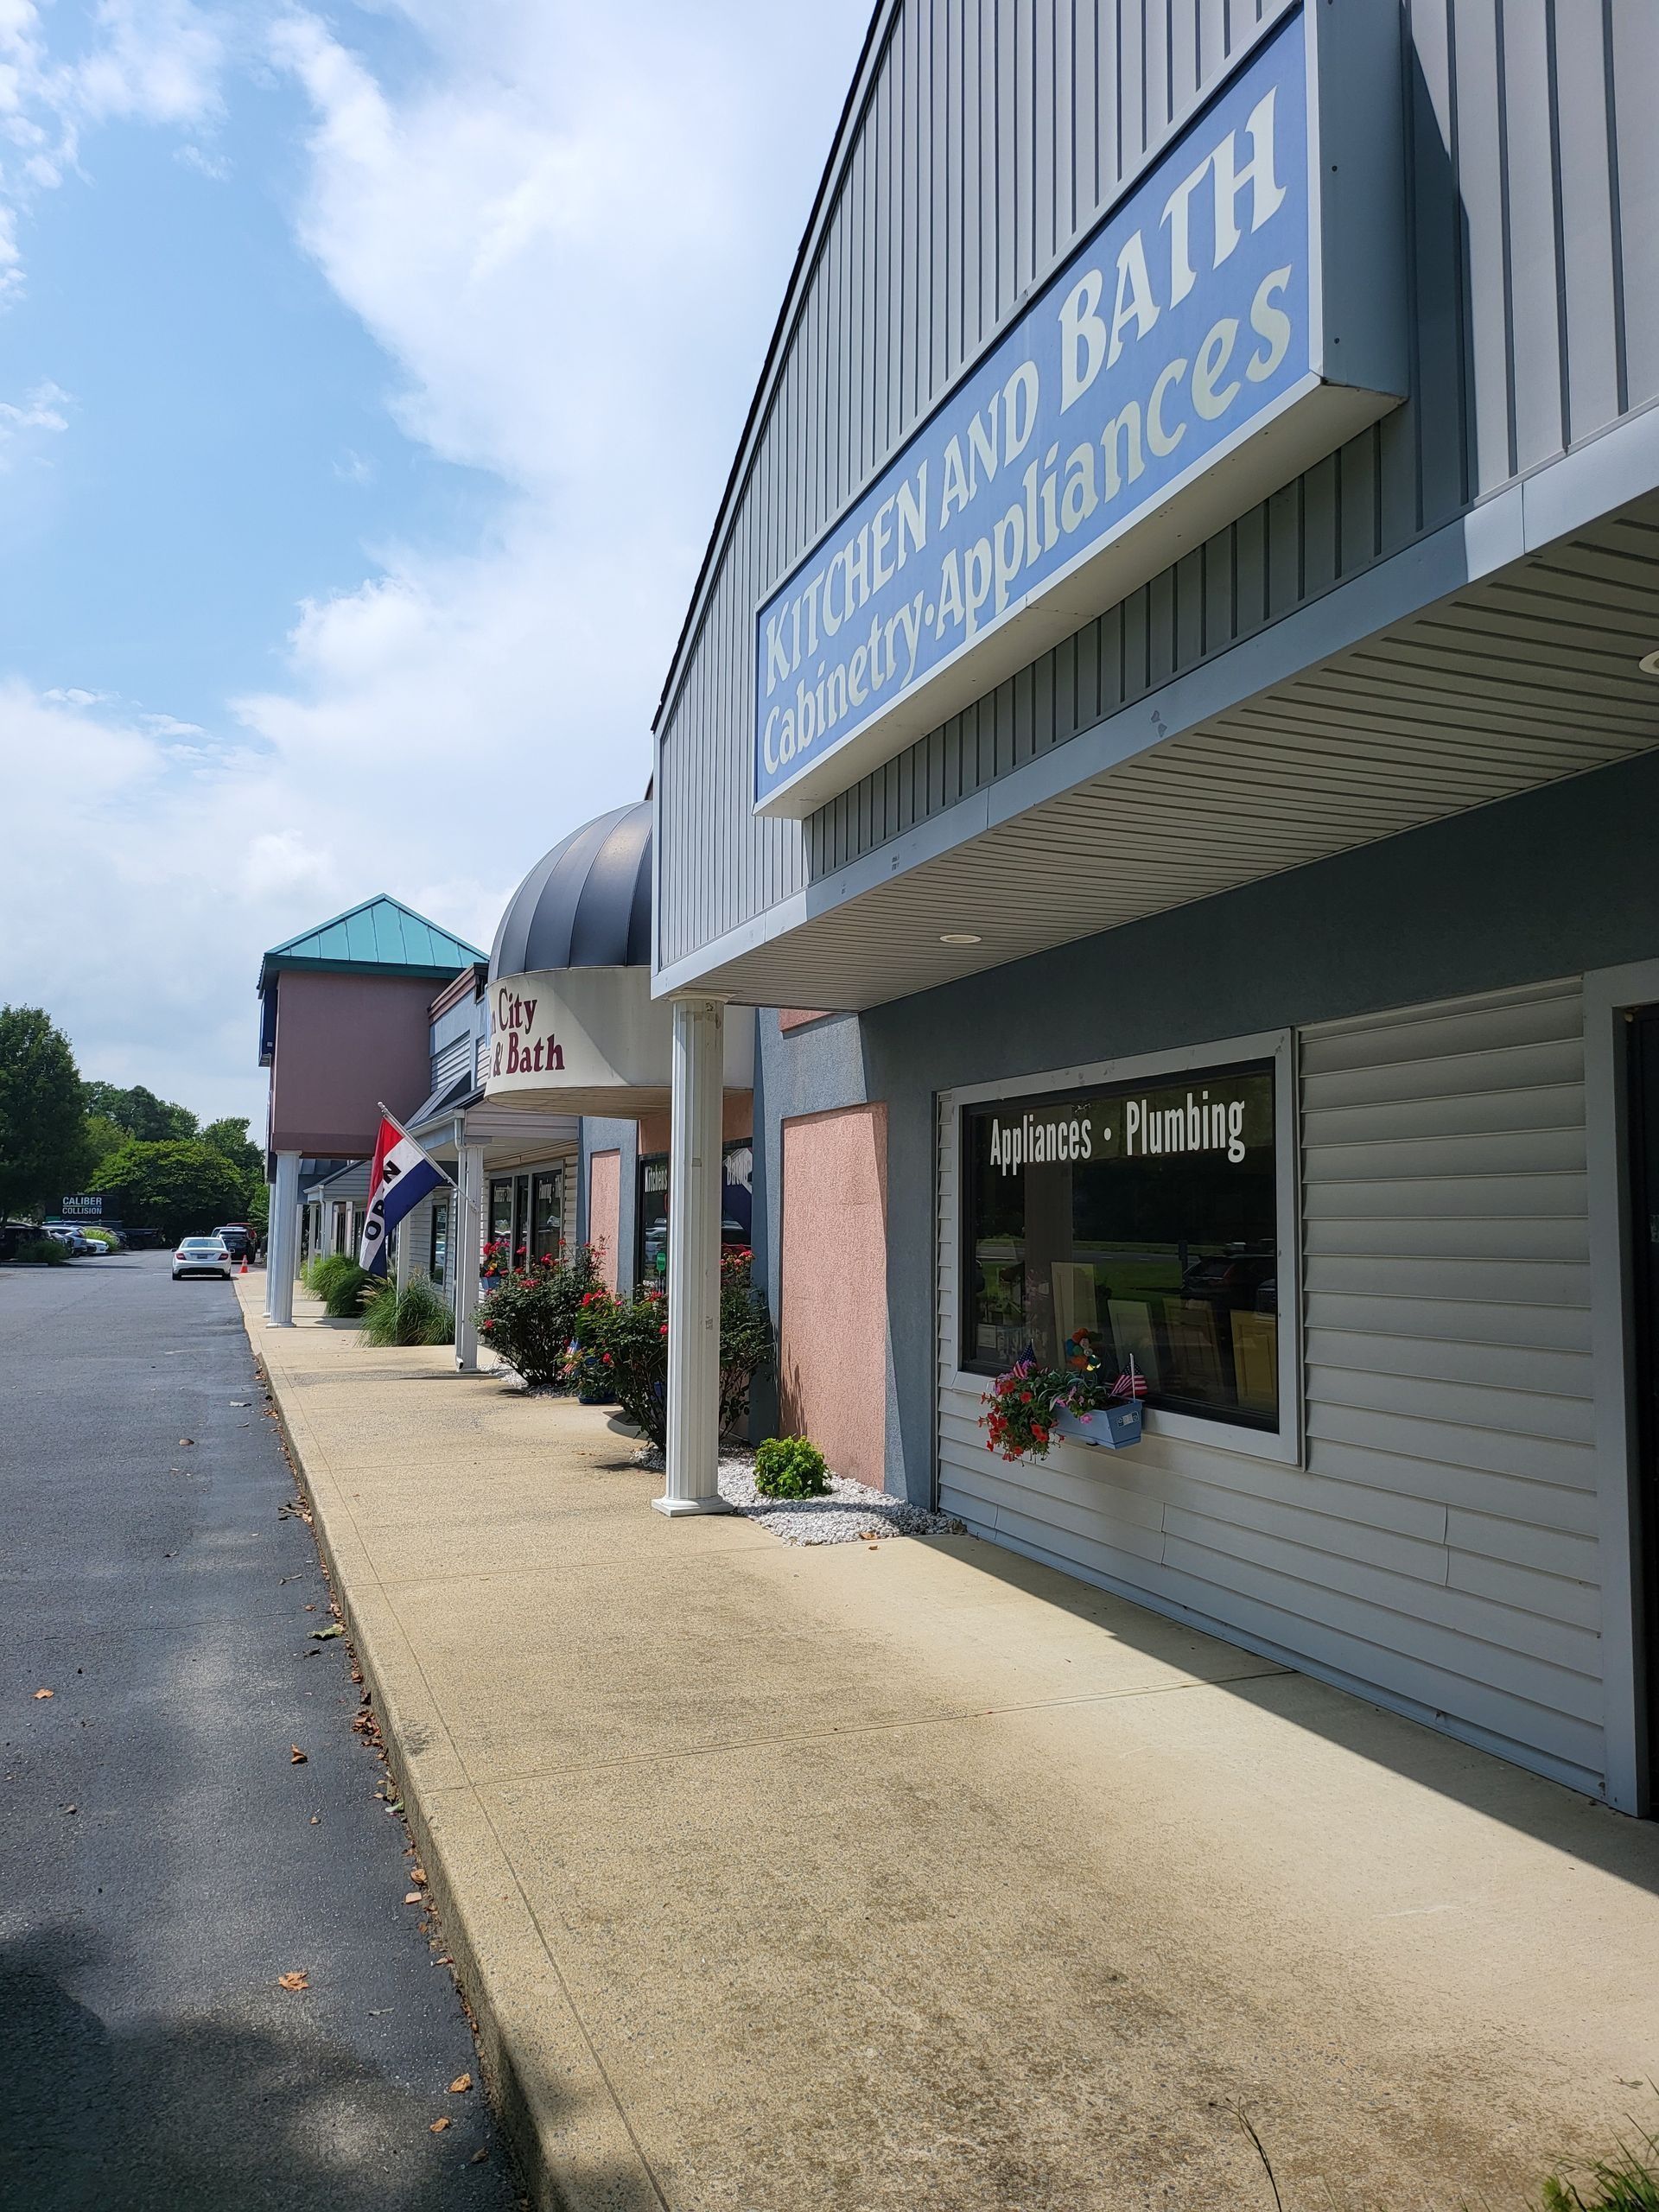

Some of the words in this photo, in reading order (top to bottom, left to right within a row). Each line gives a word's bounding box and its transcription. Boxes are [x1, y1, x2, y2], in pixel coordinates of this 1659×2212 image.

[766, 458, 928, 698] KITCHEN
[938, 359, 1039, 533] AND
[1058, 85, 1287, 416] BATH
[499, 986, 537, 1034] City
[493, 1041, 504, 1078] &
[505, 1033, 565, 1074] Bath
[989, 1114, 1092, 1177] Appliances
[1126, 1090, 1245, 1164] Plumbing
[62, 1197, 102, 1205] CALIBER
[365, 1160, 402, 1241] OPN
